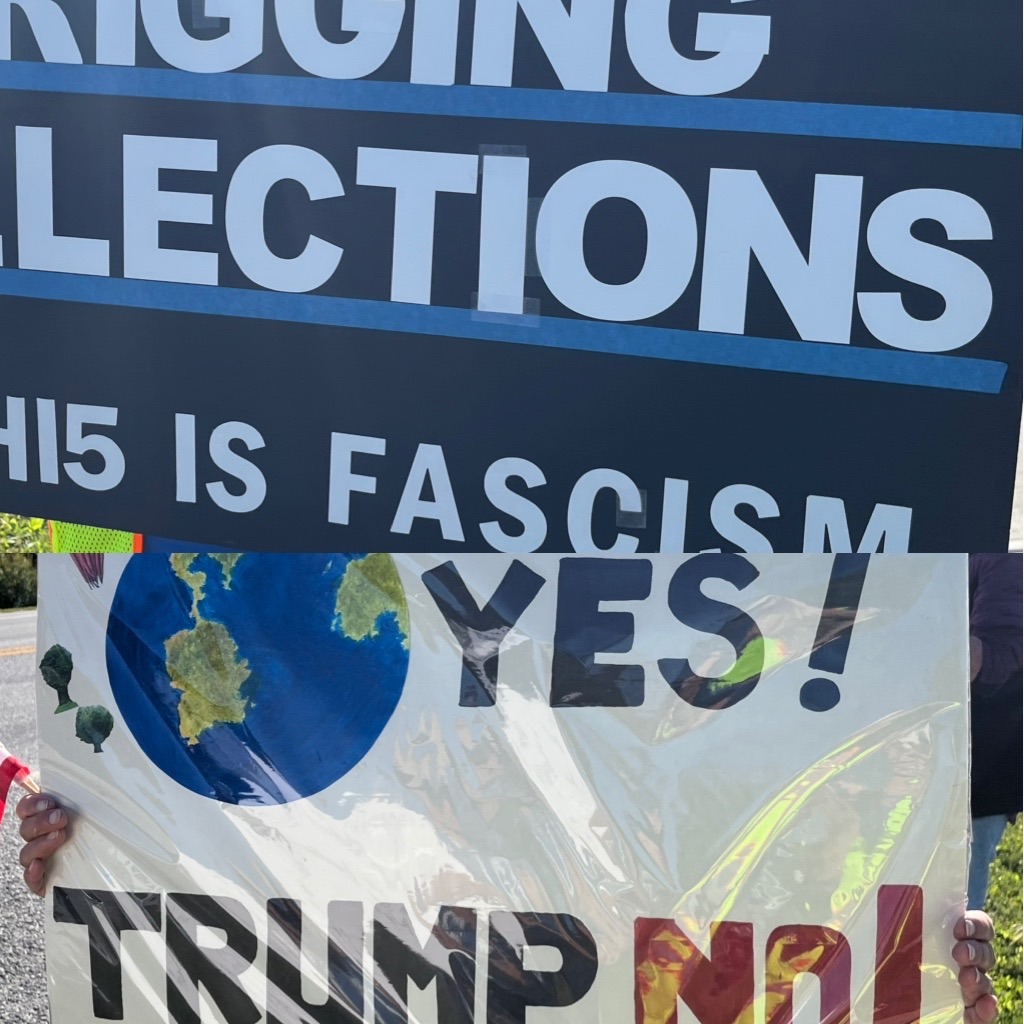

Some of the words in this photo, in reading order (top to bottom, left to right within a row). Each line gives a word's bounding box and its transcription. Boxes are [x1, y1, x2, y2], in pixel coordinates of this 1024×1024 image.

[175, 413, 267, 513] IS
[328, 432, 913, 553] FASCISM
[421, 553, 872, 712] YES!
[52, 886, 599, 1024] TRUMP
